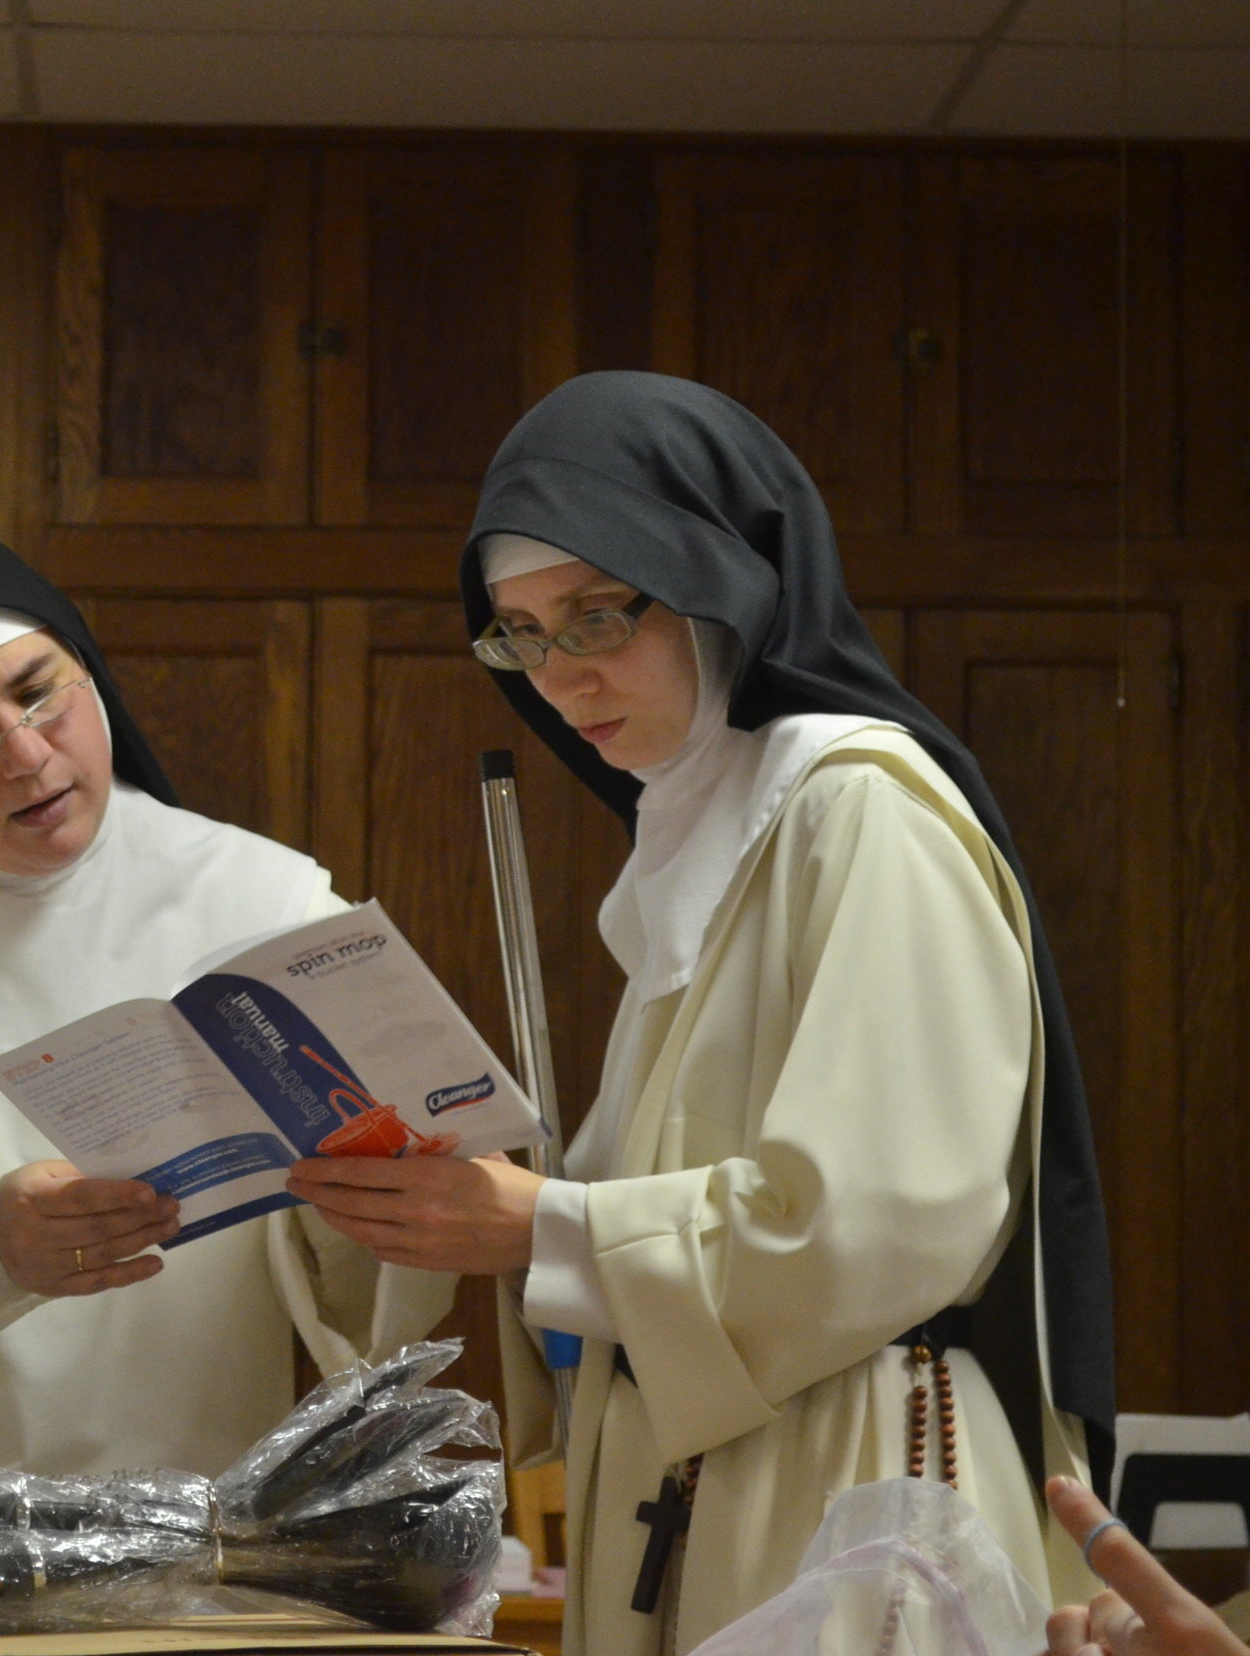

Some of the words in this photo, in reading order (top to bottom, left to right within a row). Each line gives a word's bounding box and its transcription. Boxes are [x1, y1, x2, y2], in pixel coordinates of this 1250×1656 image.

[286, 952, 335, 976] spin
[335, 934, 388, 959] mop
[231, 991, 289, 1053] manual
[216, 992, 330, 1128] instruction
[429, 1081, 491, 1110] Cleanger
